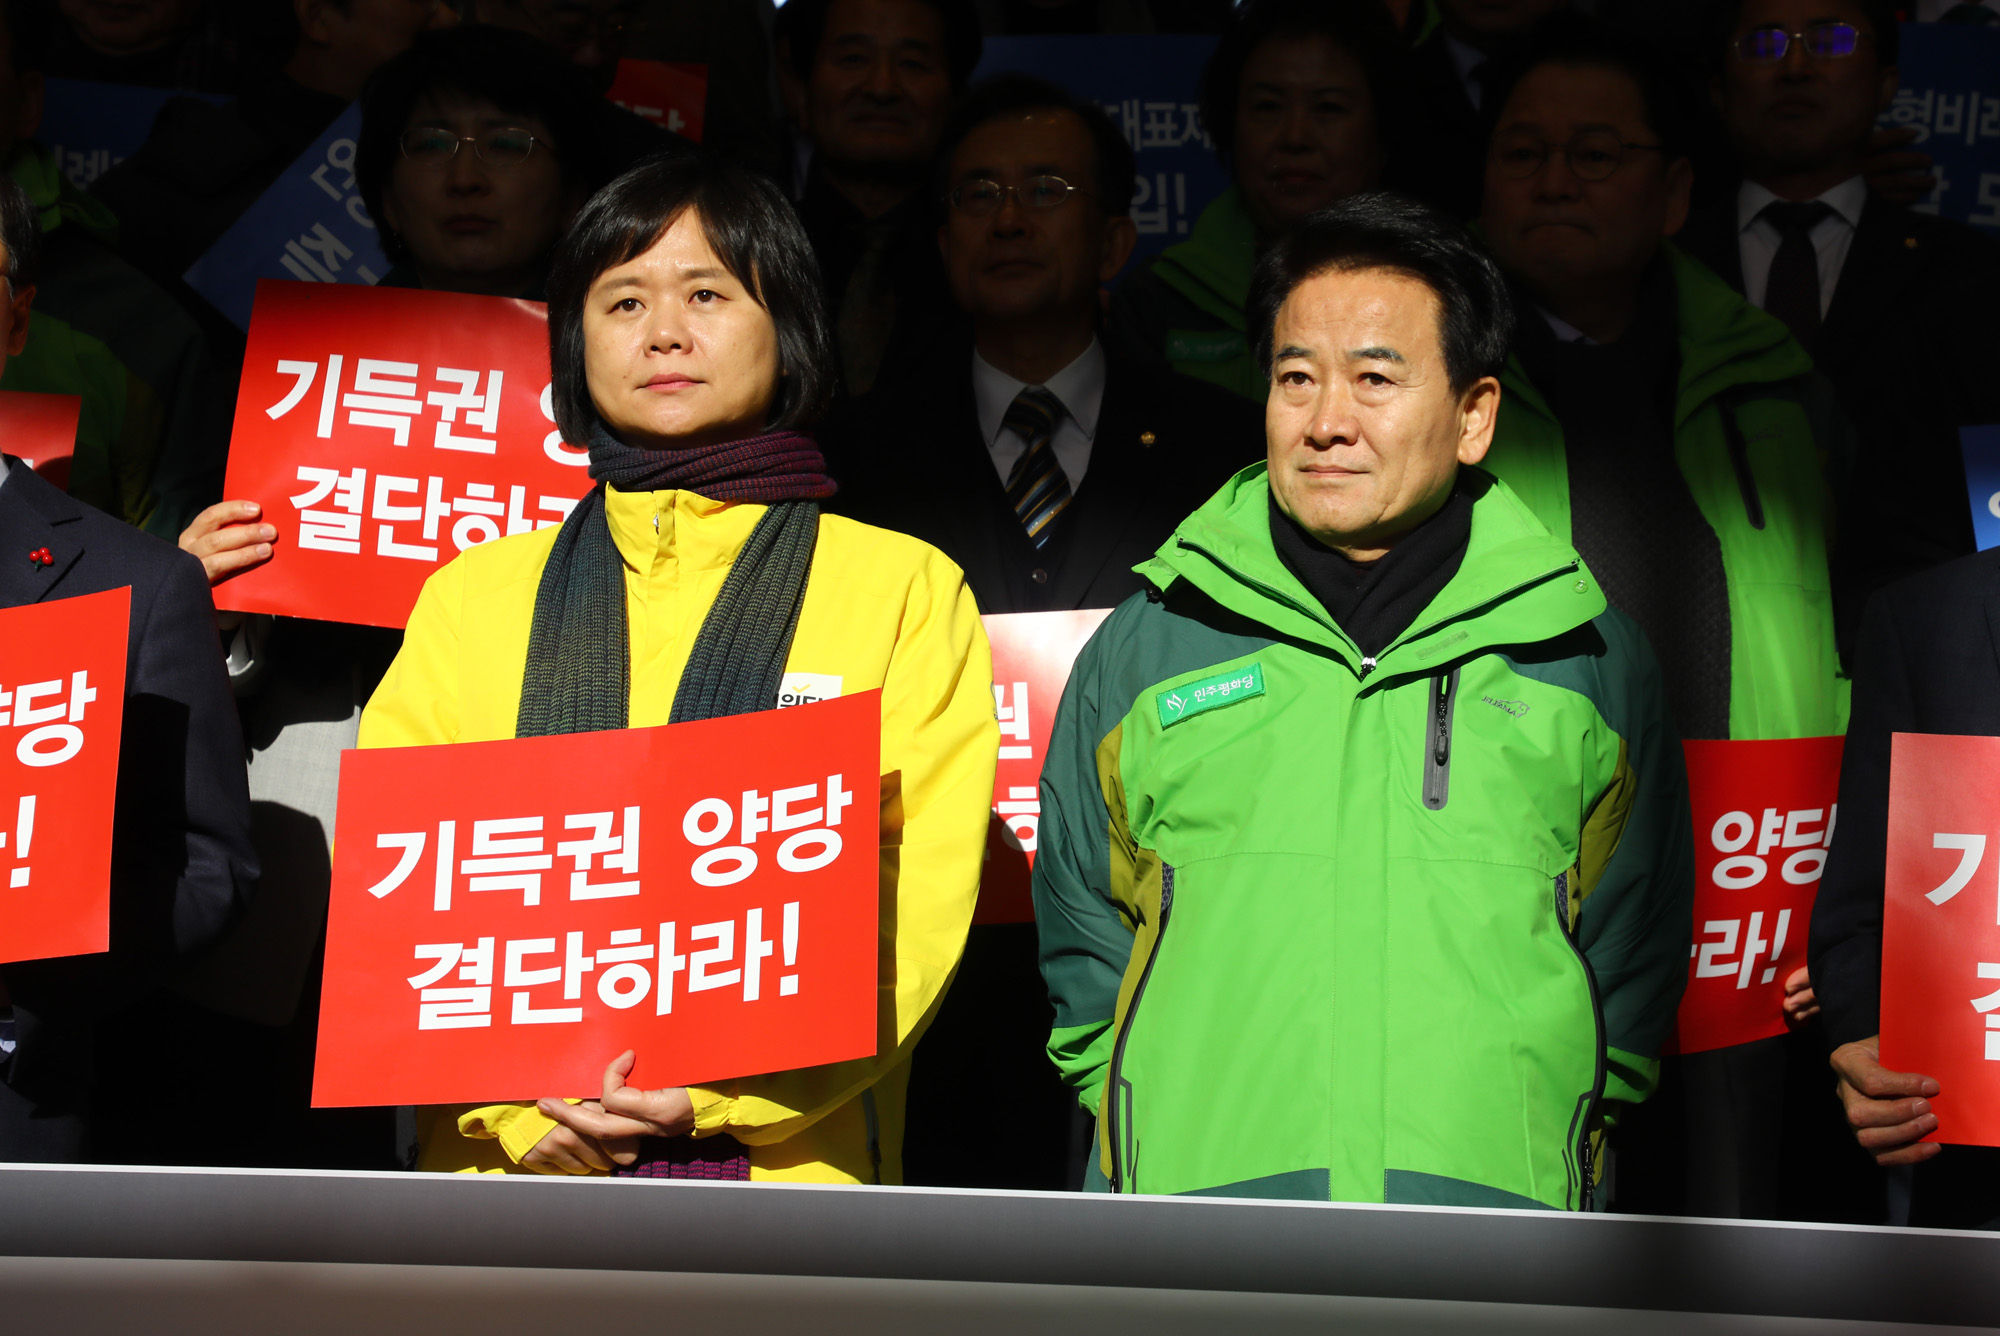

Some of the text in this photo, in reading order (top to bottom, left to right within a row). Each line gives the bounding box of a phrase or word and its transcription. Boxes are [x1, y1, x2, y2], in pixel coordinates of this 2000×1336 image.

[265, 354, 503, 454] 기득권
[0, 670, 97, 767] 당
[1194, 674, 1254, 702] 민주평화당
[367, 773, 853, 911] 기득권 양당
[1711, 803, 1837, 889] 양당
[407, 901, 800, 1031] 결단하라!
[1690, 909, 1792, 990] 라!
